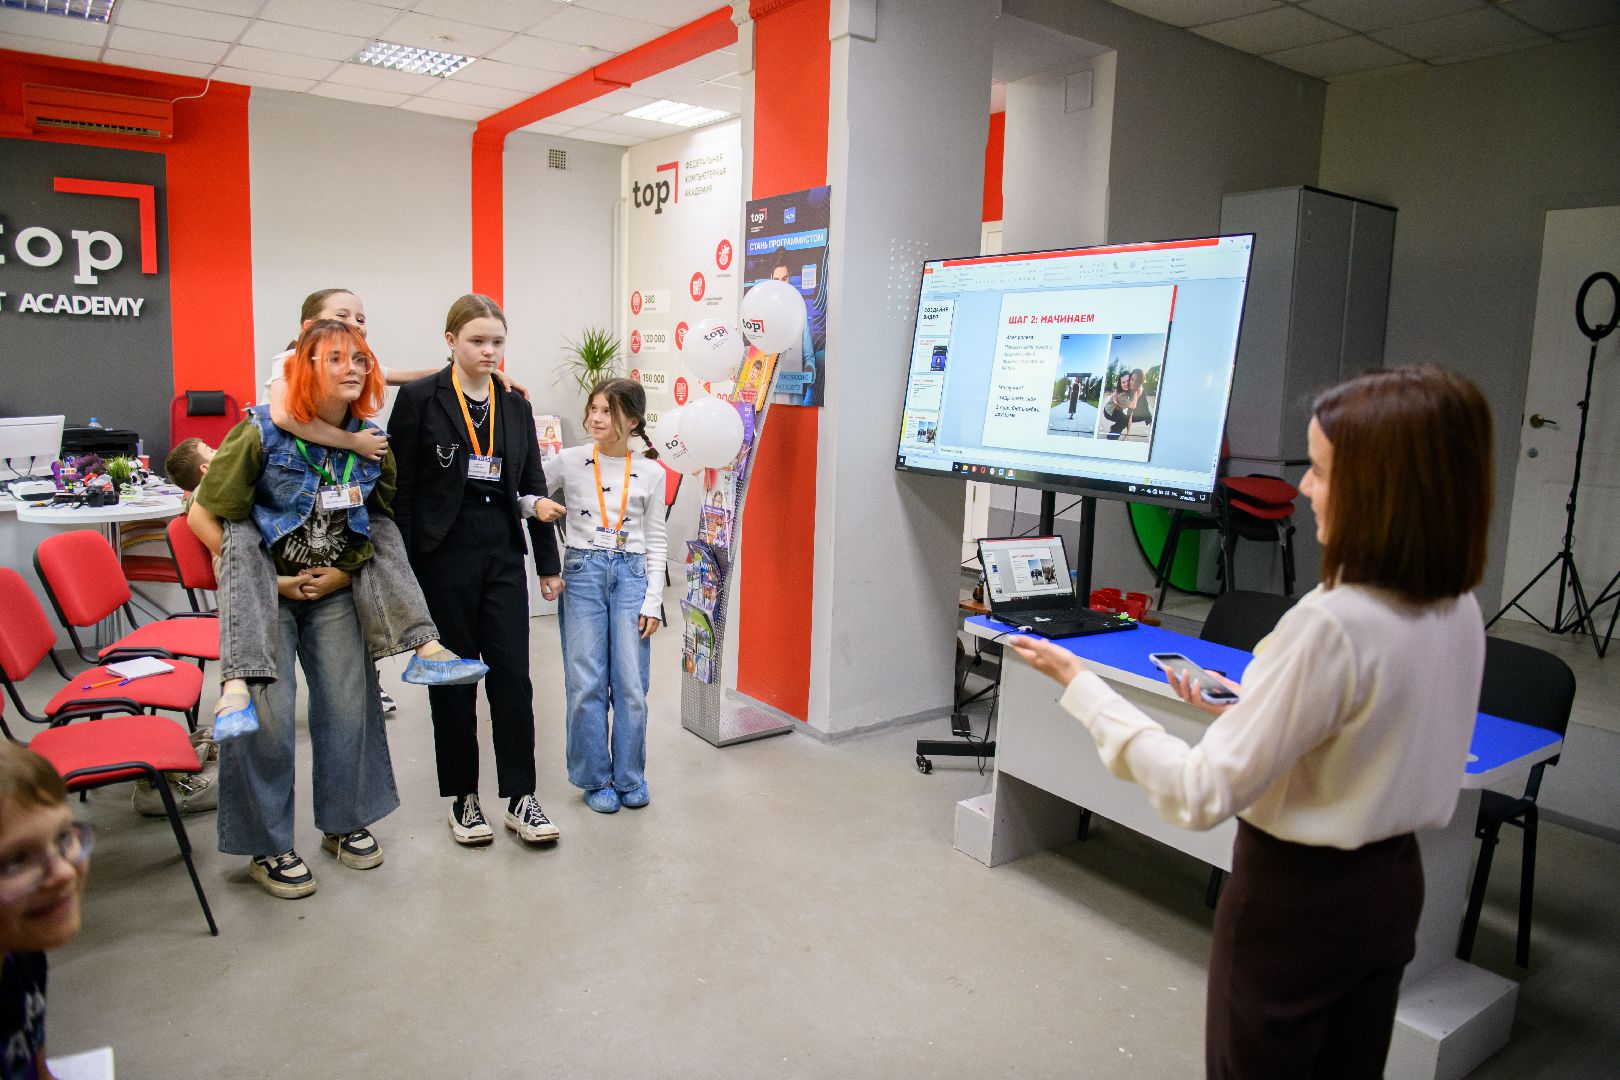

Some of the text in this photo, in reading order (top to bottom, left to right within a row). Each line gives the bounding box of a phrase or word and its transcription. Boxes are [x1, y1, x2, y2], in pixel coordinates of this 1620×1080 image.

[632, 180, 670, 215] top
[750, 213, 765, 224] top
[749, 233, 824, 251] СТАНЬ ПРОГРАММИСТОМ
[0, 224, 123, 285] op
[18, 292, 145, 317] ACADEMY
[644, 294, 656, 305] 380
[1008, 313, 1095, 325] ШАГ 2: НАЧИНАЕМ
[703, 328, 725, 341] top
[665, 439, 680, 450] to
